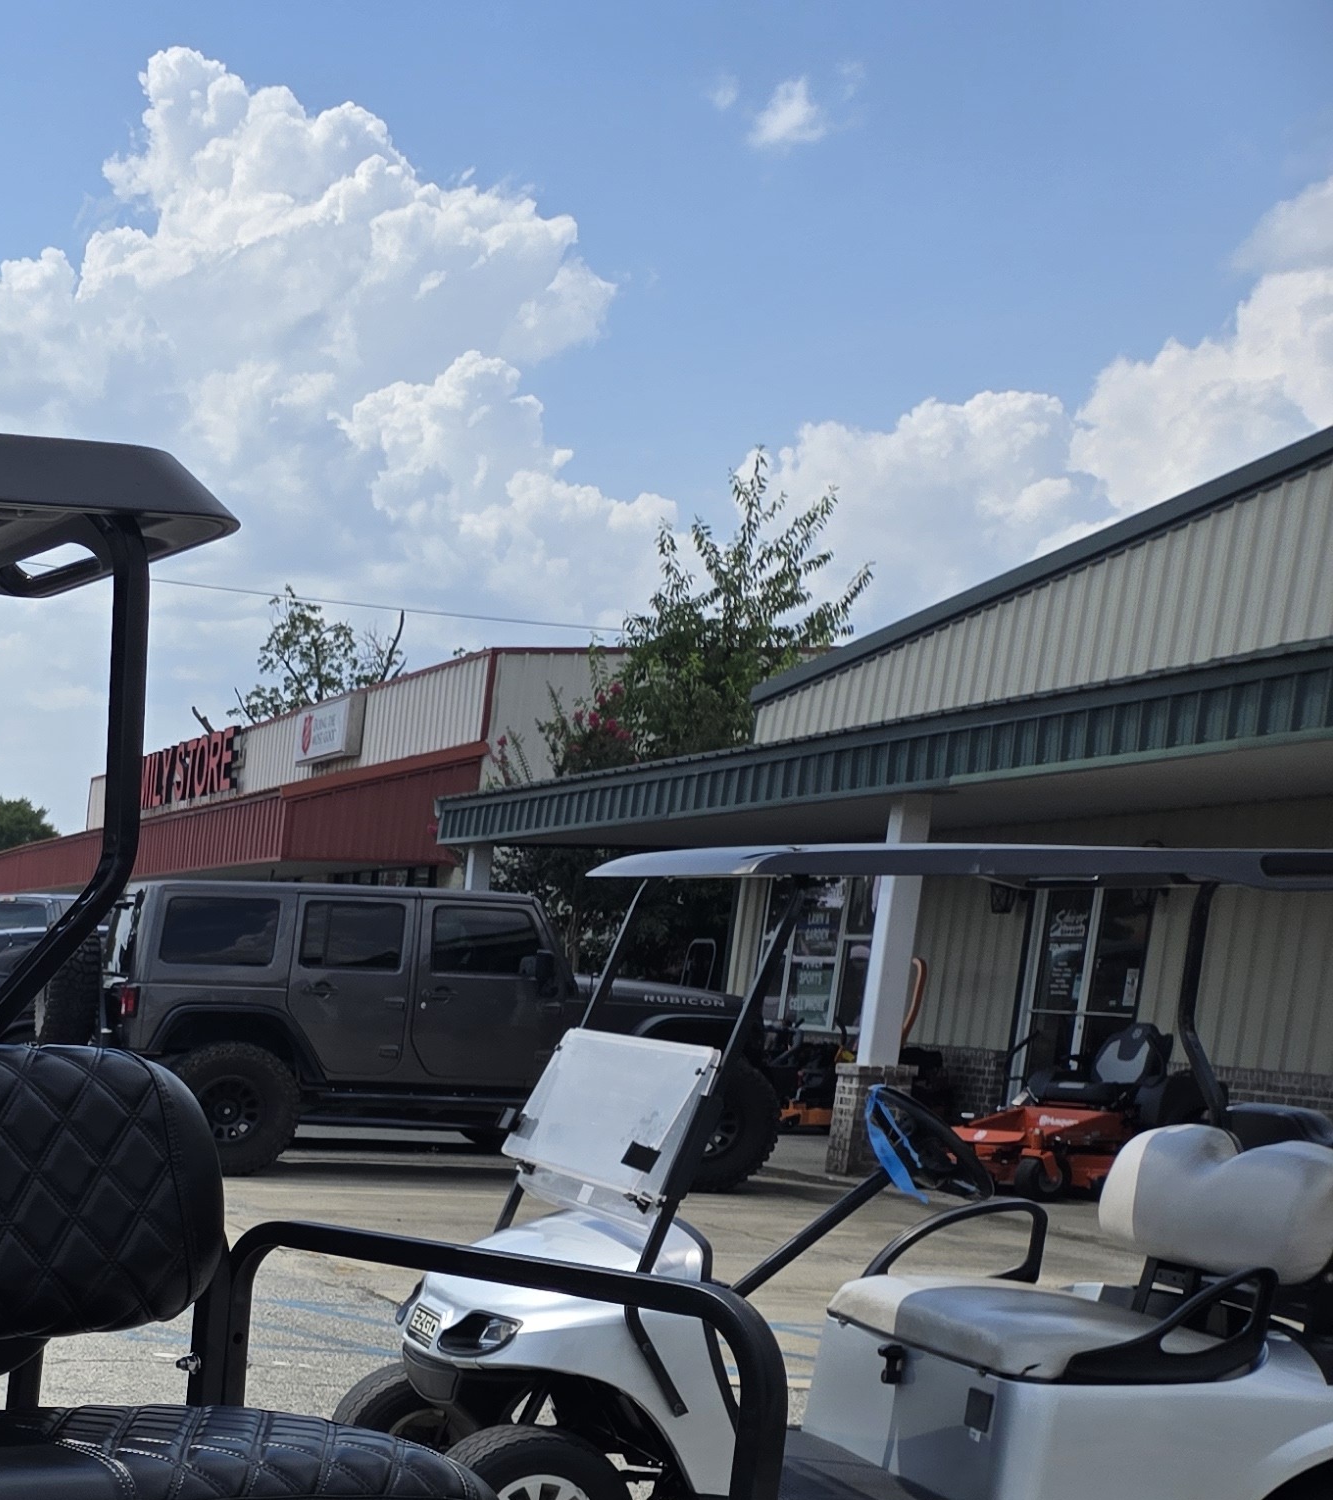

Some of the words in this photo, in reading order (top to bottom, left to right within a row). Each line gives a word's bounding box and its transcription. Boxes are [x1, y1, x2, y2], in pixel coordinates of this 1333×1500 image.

[141, 748, 173, 810] MILY
[173, 726, 237, 802] STORE
[644, 994, 725, 1008] RUBICON
[411, 1309, 438, 1338] EZGO
